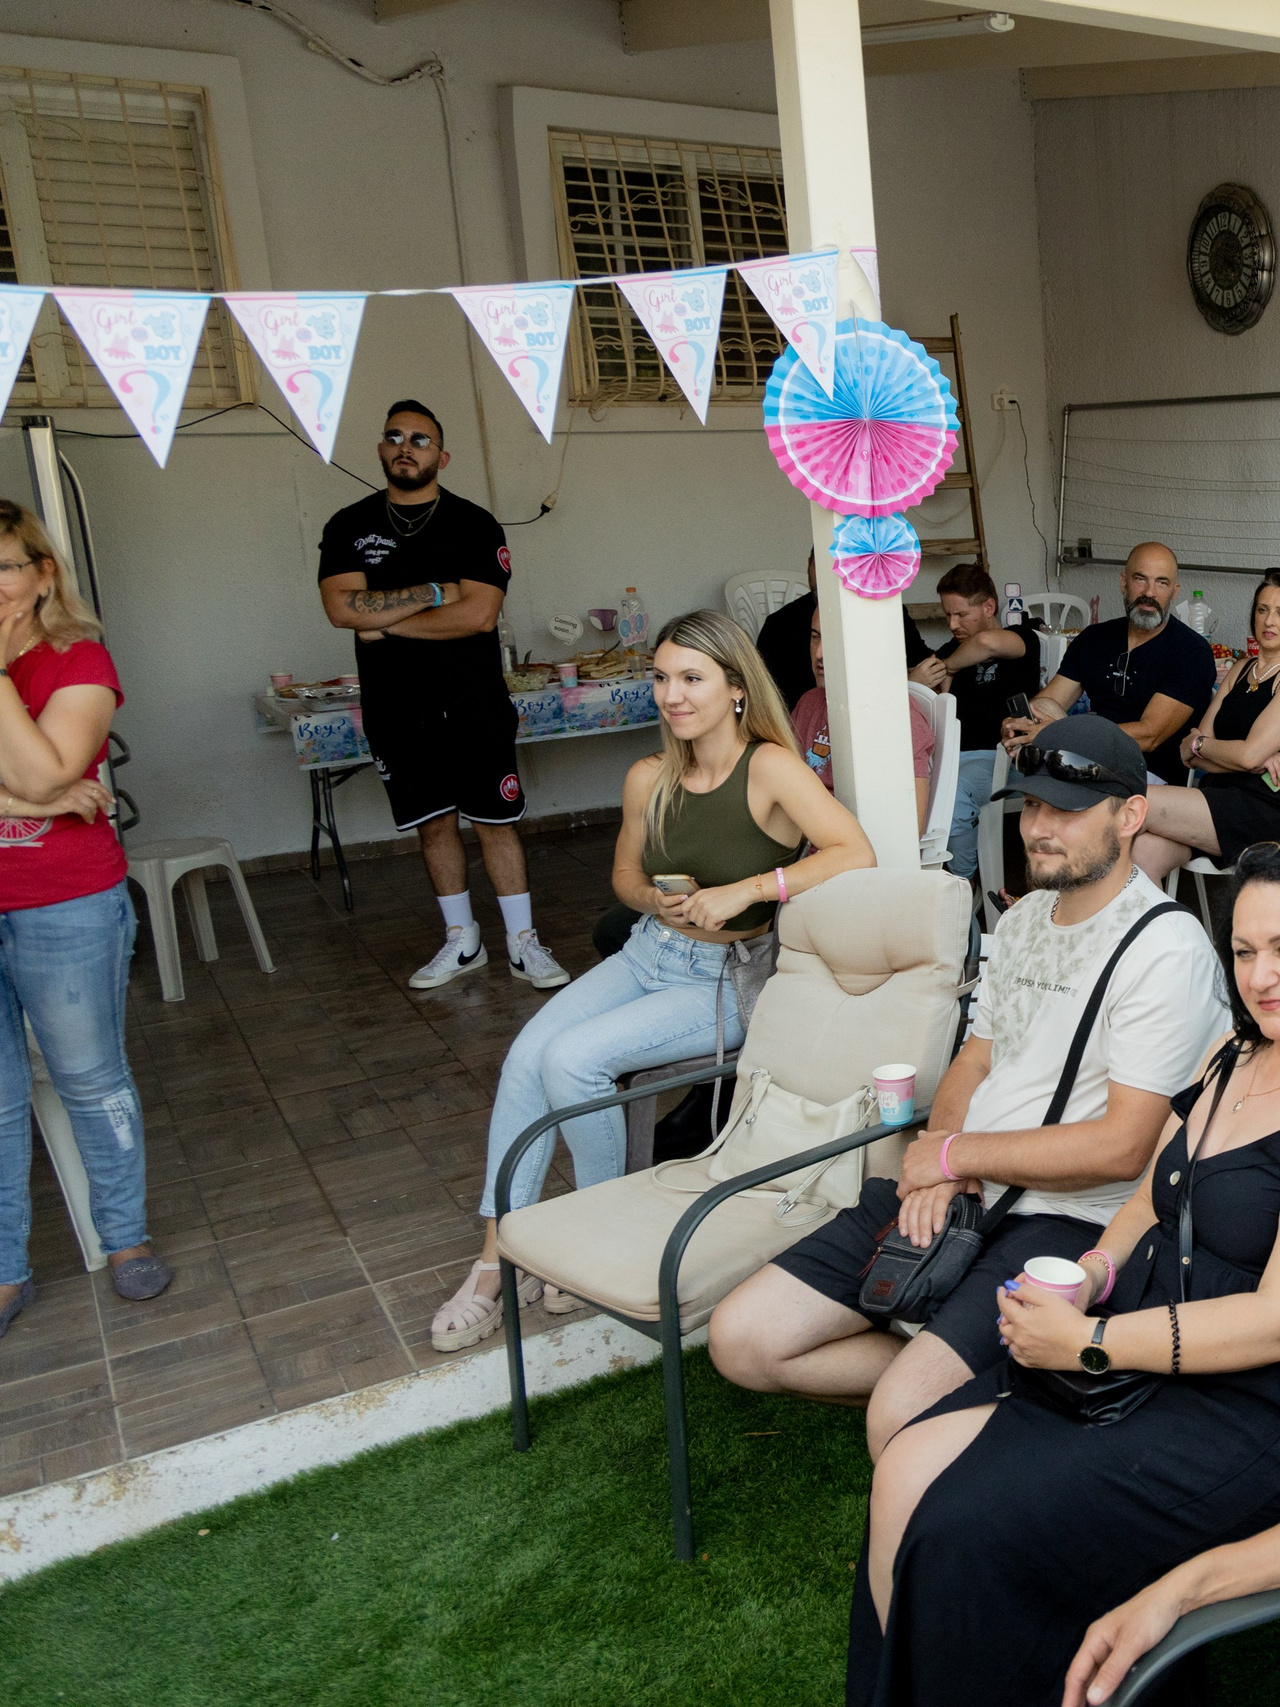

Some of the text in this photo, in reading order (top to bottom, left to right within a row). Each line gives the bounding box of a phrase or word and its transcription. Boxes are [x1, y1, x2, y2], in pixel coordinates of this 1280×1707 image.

[768, 272, 794, 296] Girl
[649, 289, 676, 312] Girl
[802, 297, 829, 312] BOY
[97, 308, 135, 334] Girl
[265, 310, 299, 336] Girl
[487, 301, 517, 325] Girl
[683, 316, 711, 332] BOY
[525, 332, 555, 346] BOY
[143, 345, 181, 360] BOY
[307, 345, 341, 360] BOY
[554, 616, 577, 629] Coming
[609, 684, 650, 705] Boy?
[297, 718, 346, 741] Boy?
